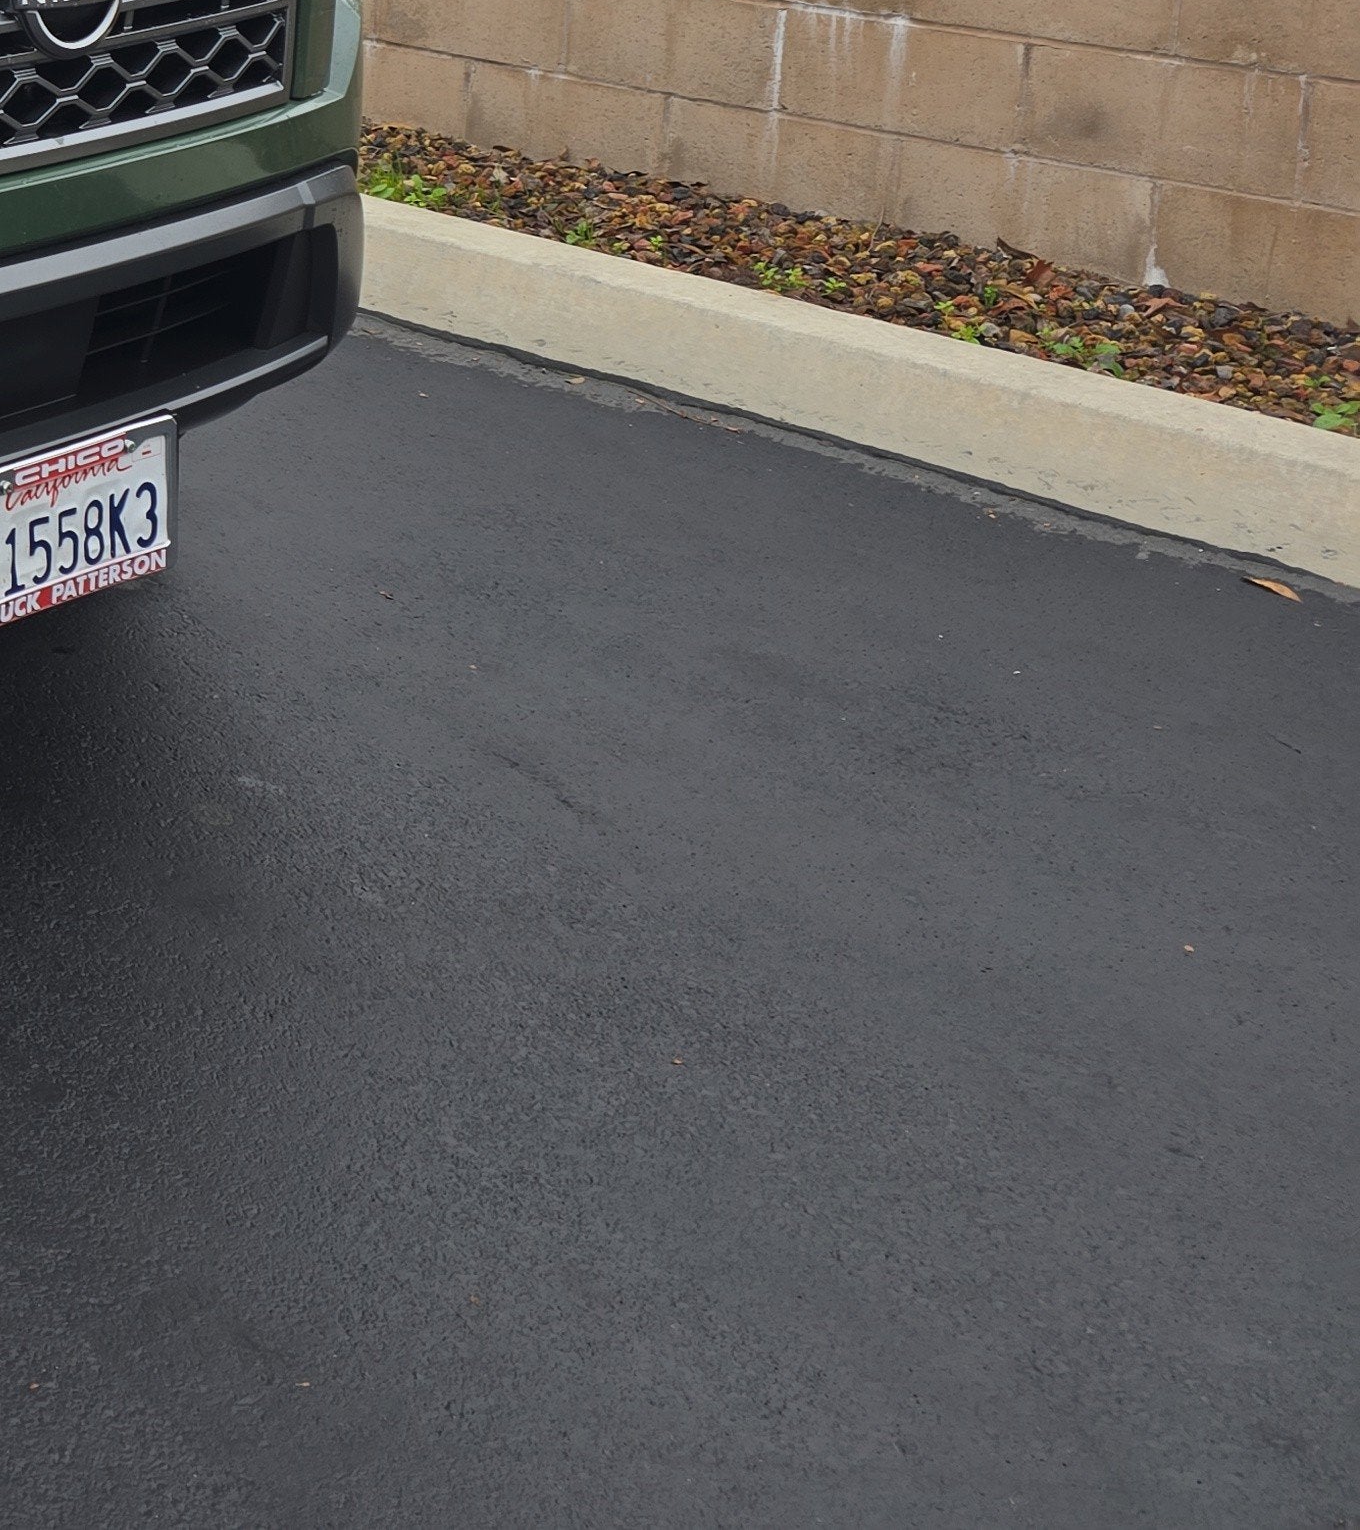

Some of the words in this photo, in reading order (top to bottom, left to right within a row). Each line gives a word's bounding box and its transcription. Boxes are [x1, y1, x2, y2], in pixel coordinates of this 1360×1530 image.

[5, 457, 132, 511] California
[15, 438, 126, 486] CHICO
[51, 549, 167, 606] PATTERSON
